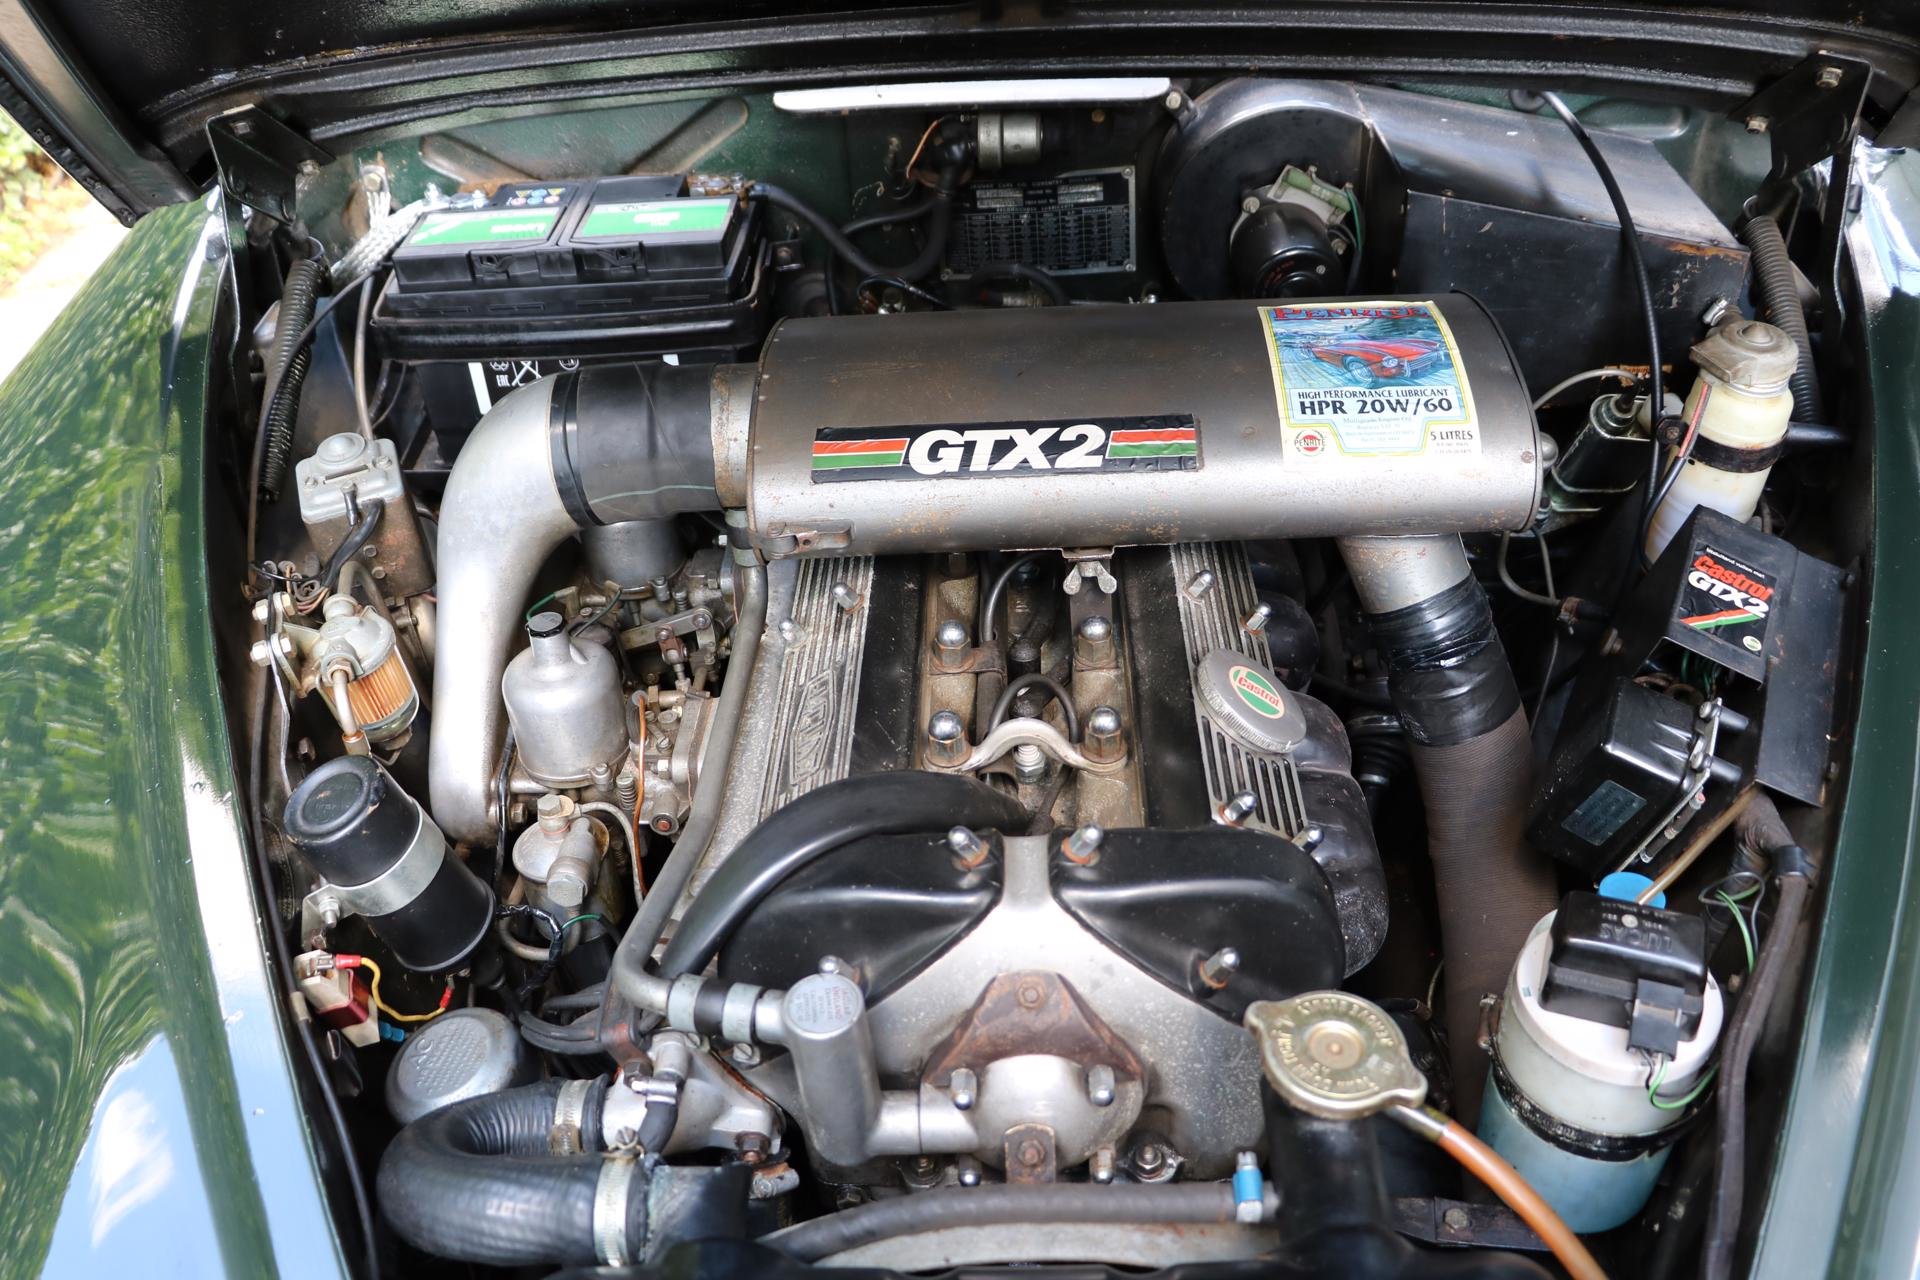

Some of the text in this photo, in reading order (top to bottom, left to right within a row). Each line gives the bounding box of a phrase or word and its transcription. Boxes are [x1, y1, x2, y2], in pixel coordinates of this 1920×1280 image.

[1298, 388, 1448, 399] HIGH PERFORMANCE LUBRICANT
[1300, 398, 1453, 415] HPR 20W/60
[1294, 439, 1325, 447] PENRITE
[1430, 430, 1473, 441] 5 LITRES
[907, 424, 1107, 475] GTX2
[1694, 555, 1776, 600] Castrol
[1688, 570, 1769, 618] GTX2
[1238, 676, 1279, 707] Castrol
